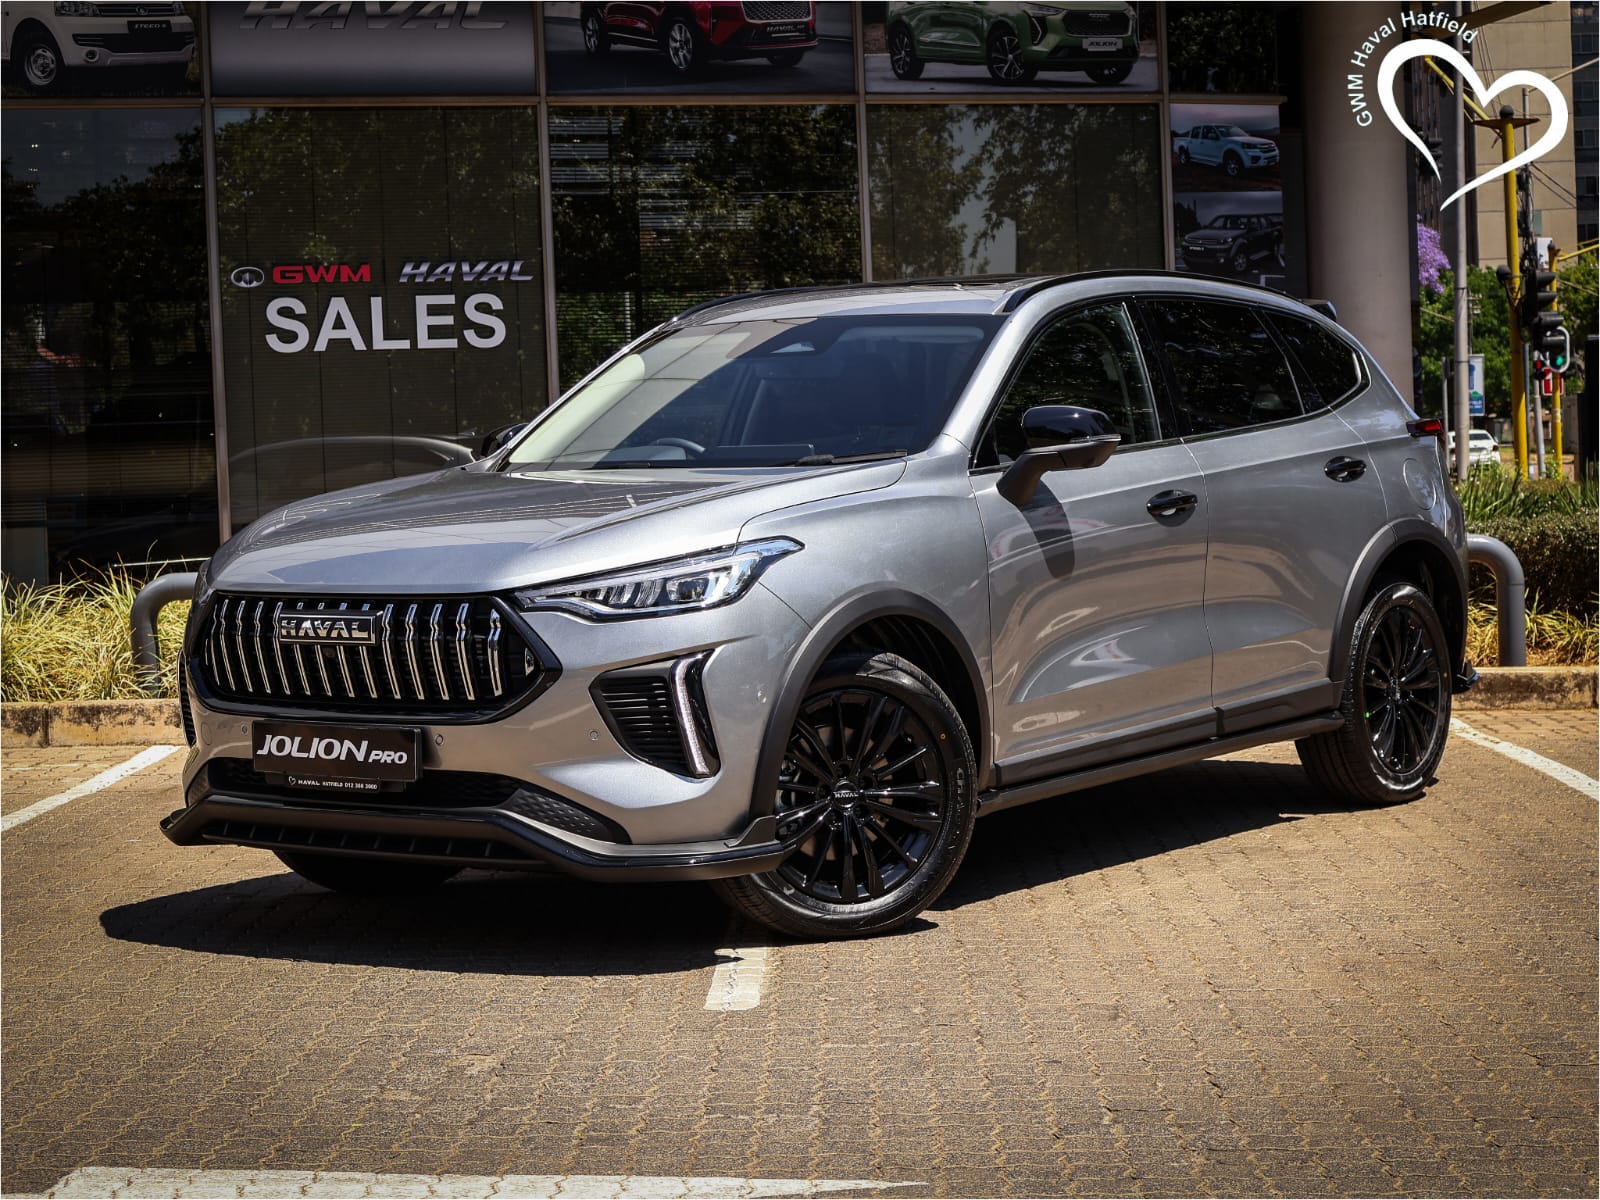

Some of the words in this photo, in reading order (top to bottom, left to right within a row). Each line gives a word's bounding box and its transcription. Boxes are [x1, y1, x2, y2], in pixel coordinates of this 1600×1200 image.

[272, 264, 371, 283] GWM
[399, 260, 535, 283] HAVAL
[265, 293, 507, 353] SALES
[281, 619, 368, 637] HAVAL
[256, 734, 369, 762] JOLION
[368, 750, 408, 764] PRO
